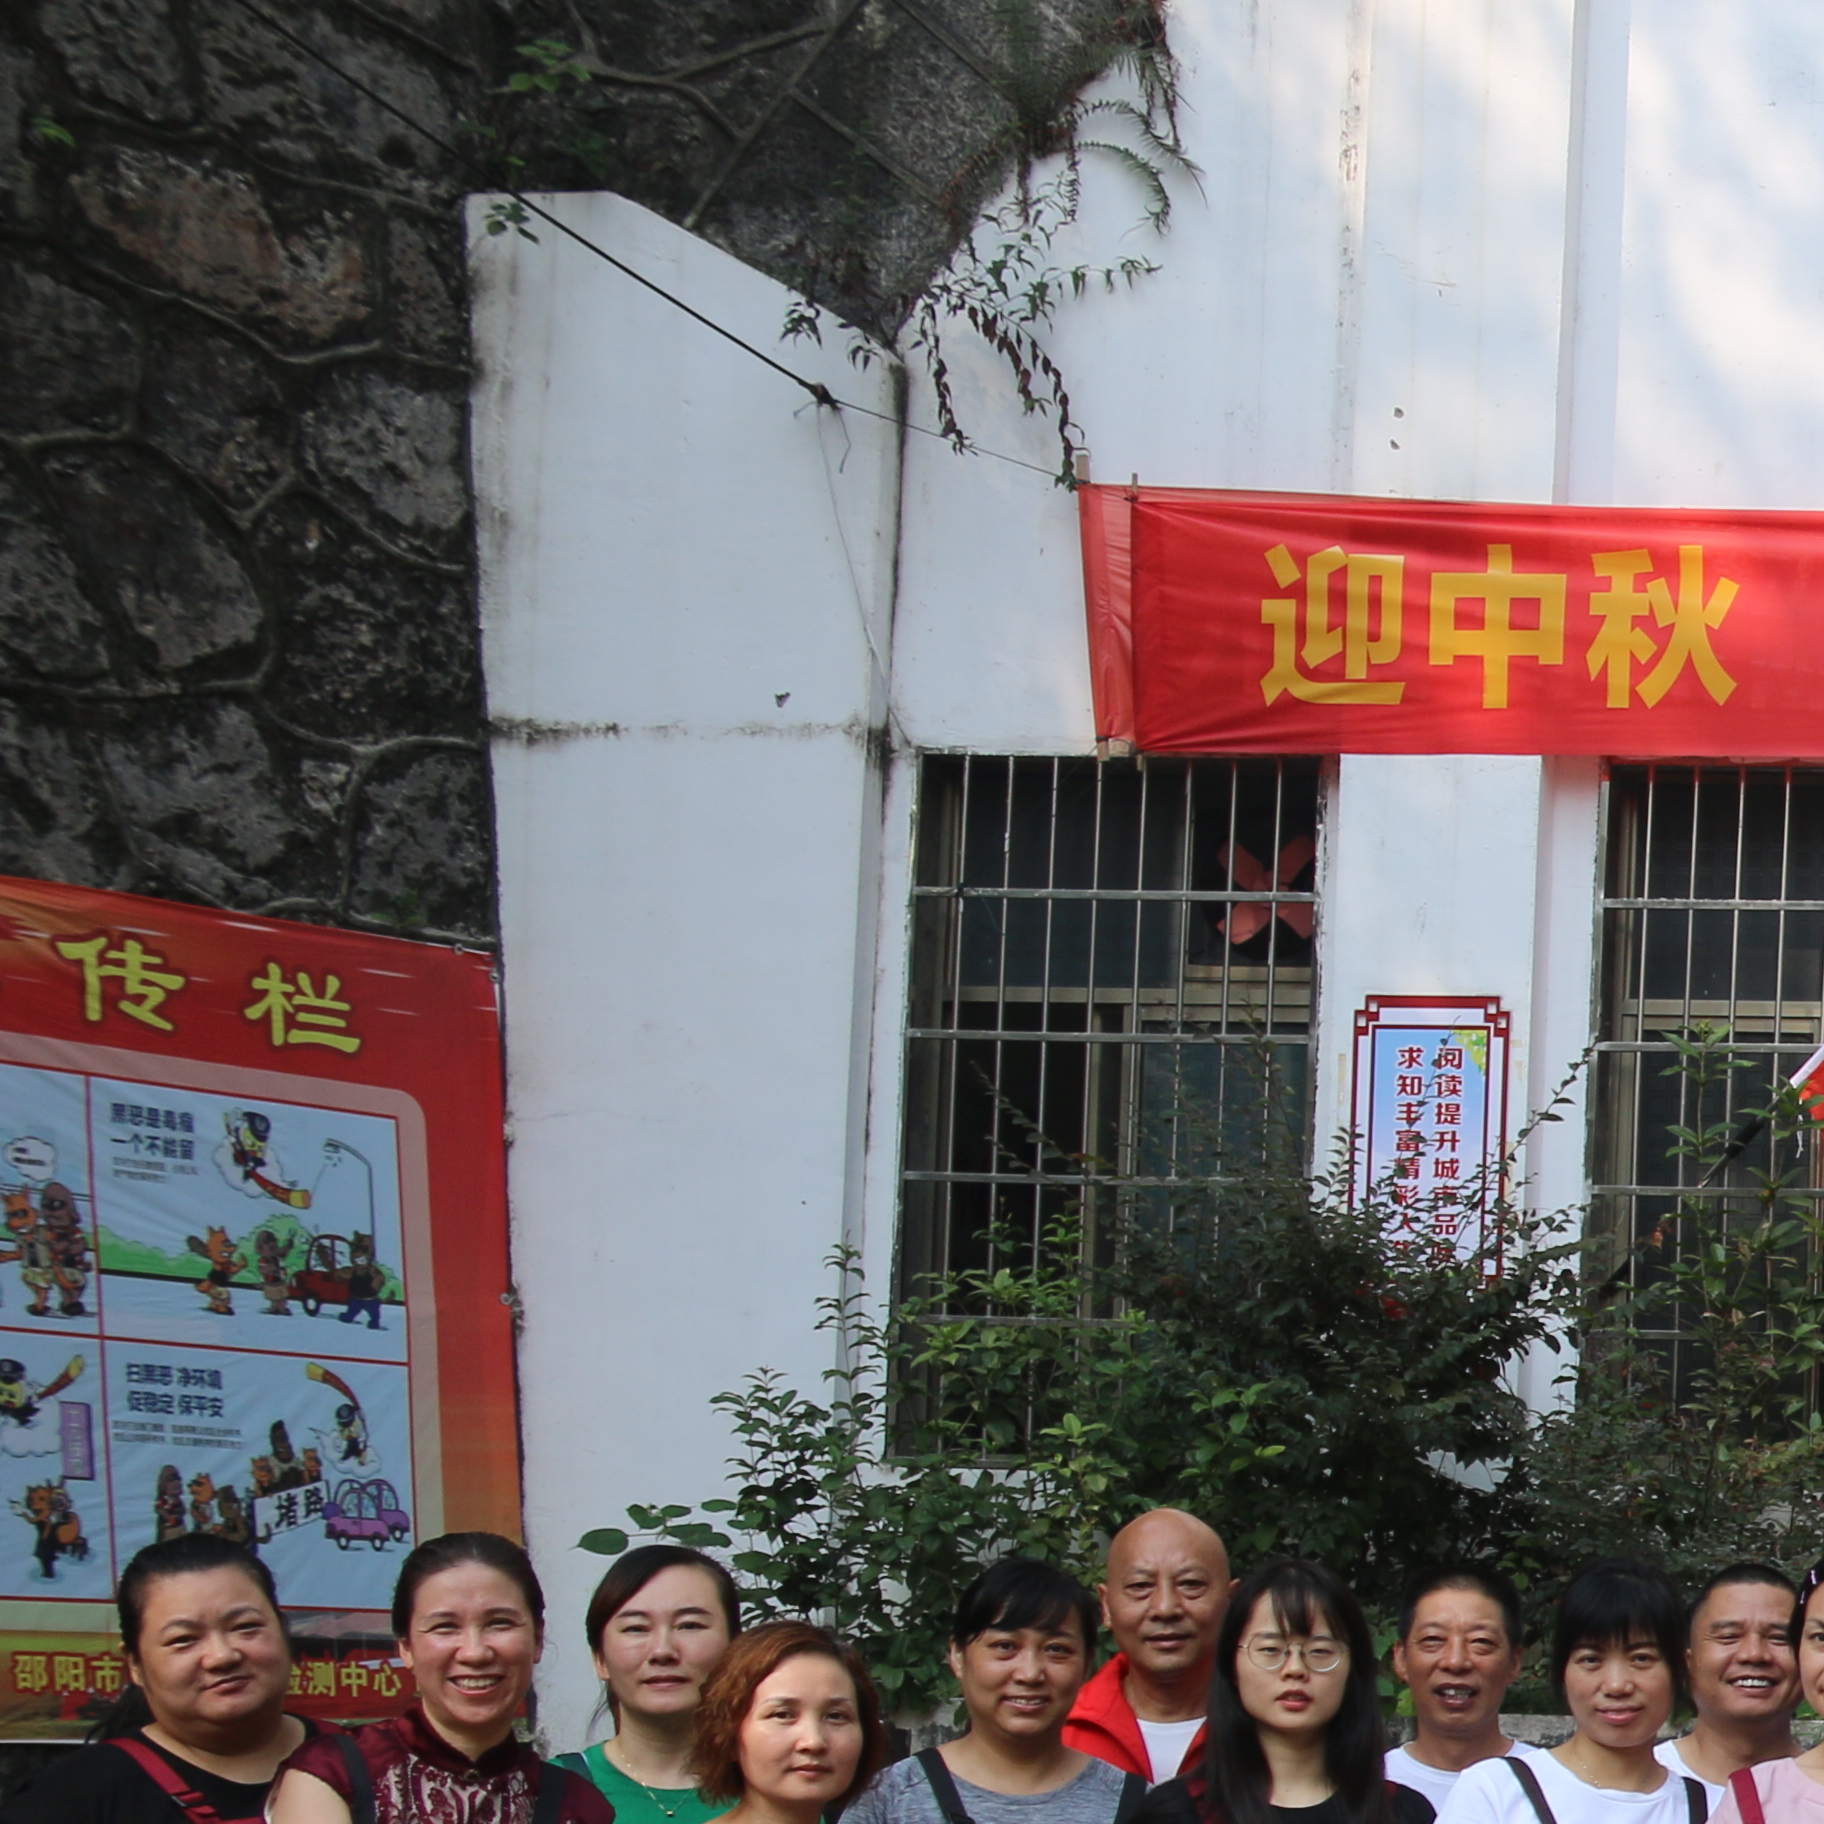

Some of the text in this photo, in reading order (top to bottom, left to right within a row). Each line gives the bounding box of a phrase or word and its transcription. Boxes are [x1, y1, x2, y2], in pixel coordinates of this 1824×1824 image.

[1260, 543, 1741, 710] 迎中秋
[55, 936, 361, 1053] 传栏
[274, 1484, 324, 1529] 堵路
[12, 1654, 127, 1693] 邵阳市
